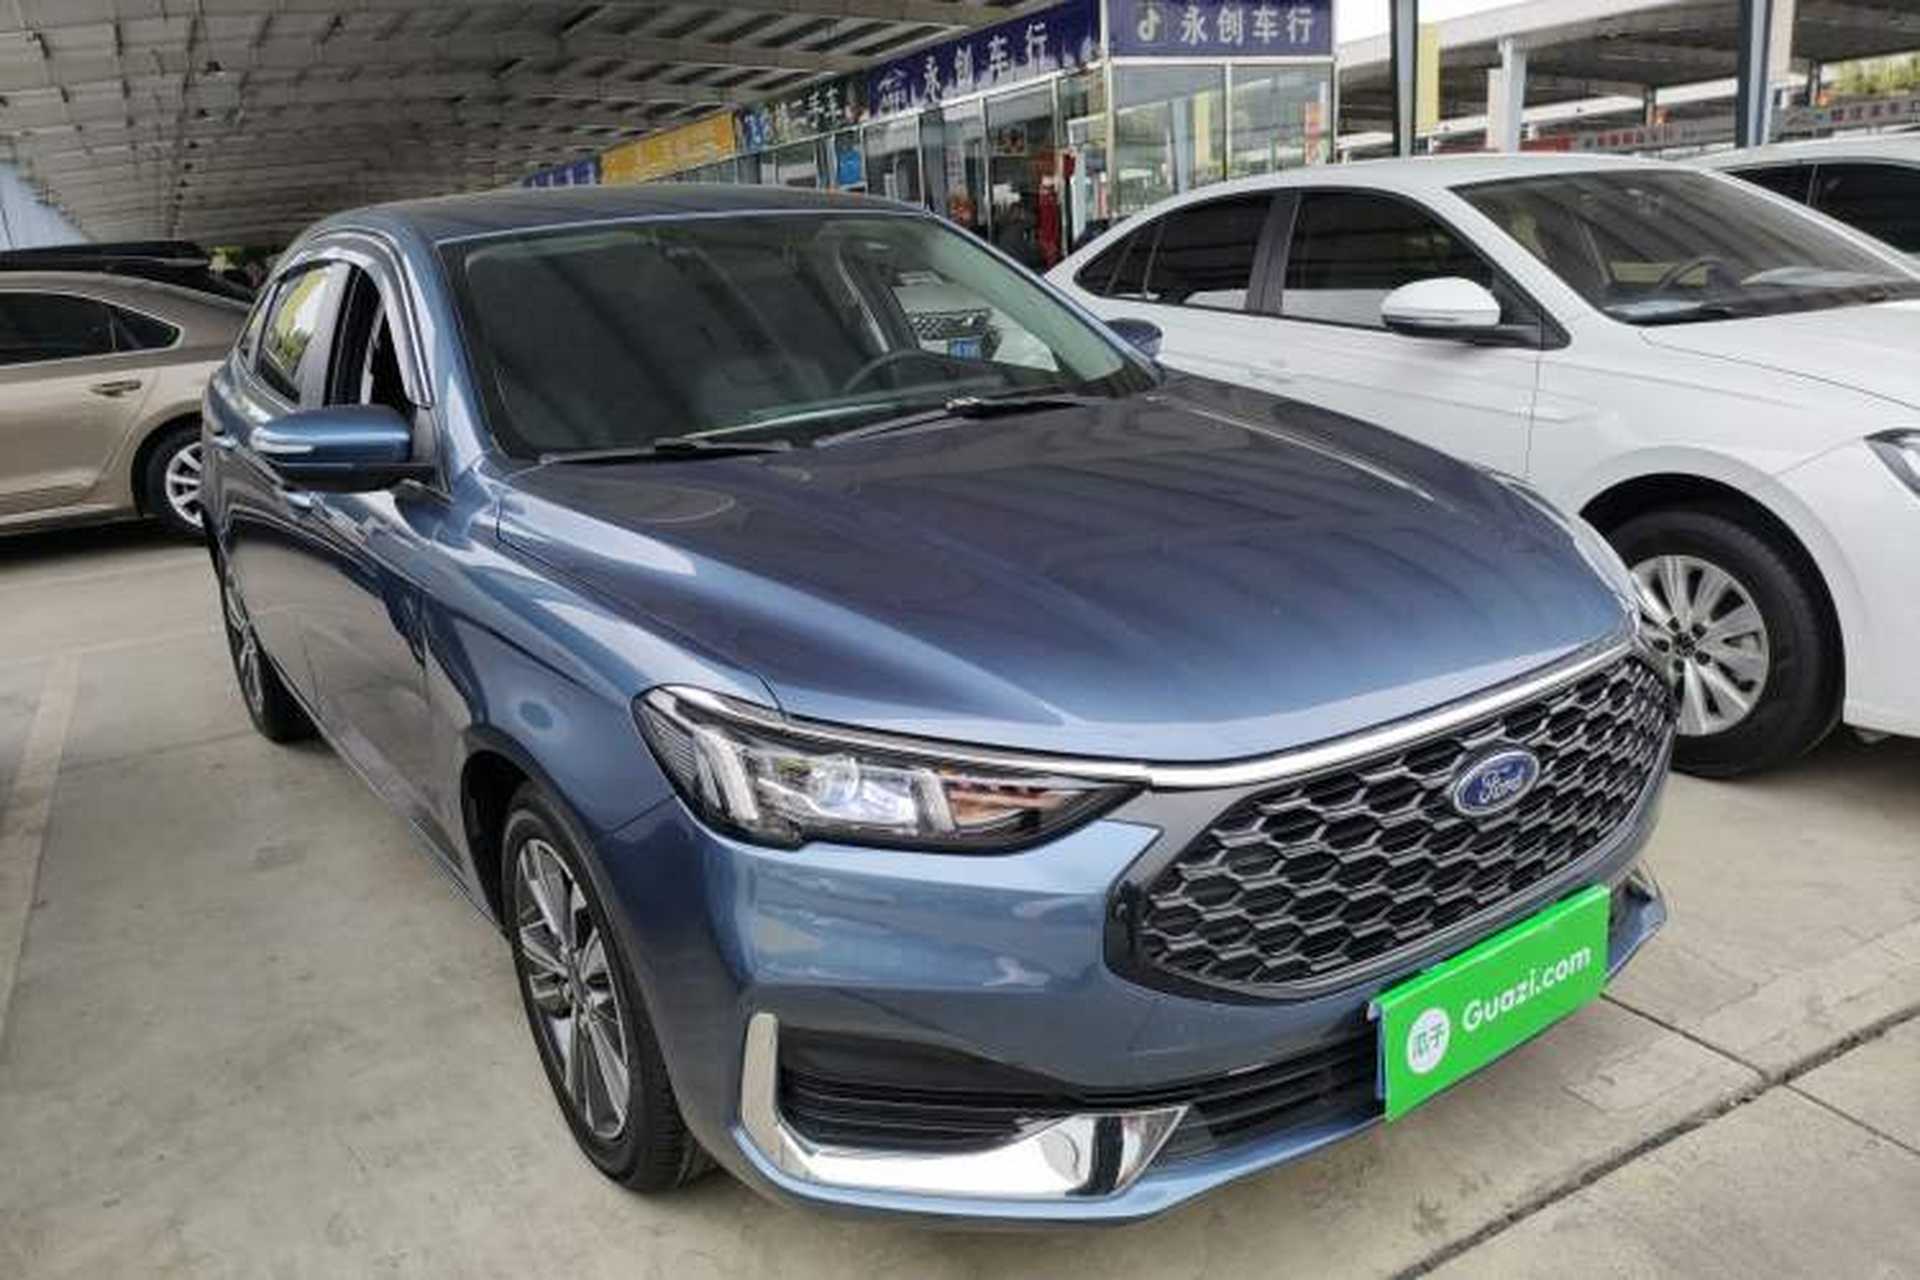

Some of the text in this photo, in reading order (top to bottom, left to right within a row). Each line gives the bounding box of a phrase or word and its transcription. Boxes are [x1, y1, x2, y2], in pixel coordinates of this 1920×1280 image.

[923, 22, 1049, 103] 永创车行
[1180, 5, 1314, 46] 永创车行
[1462, 947, 1592, 1032] Guazi.com
